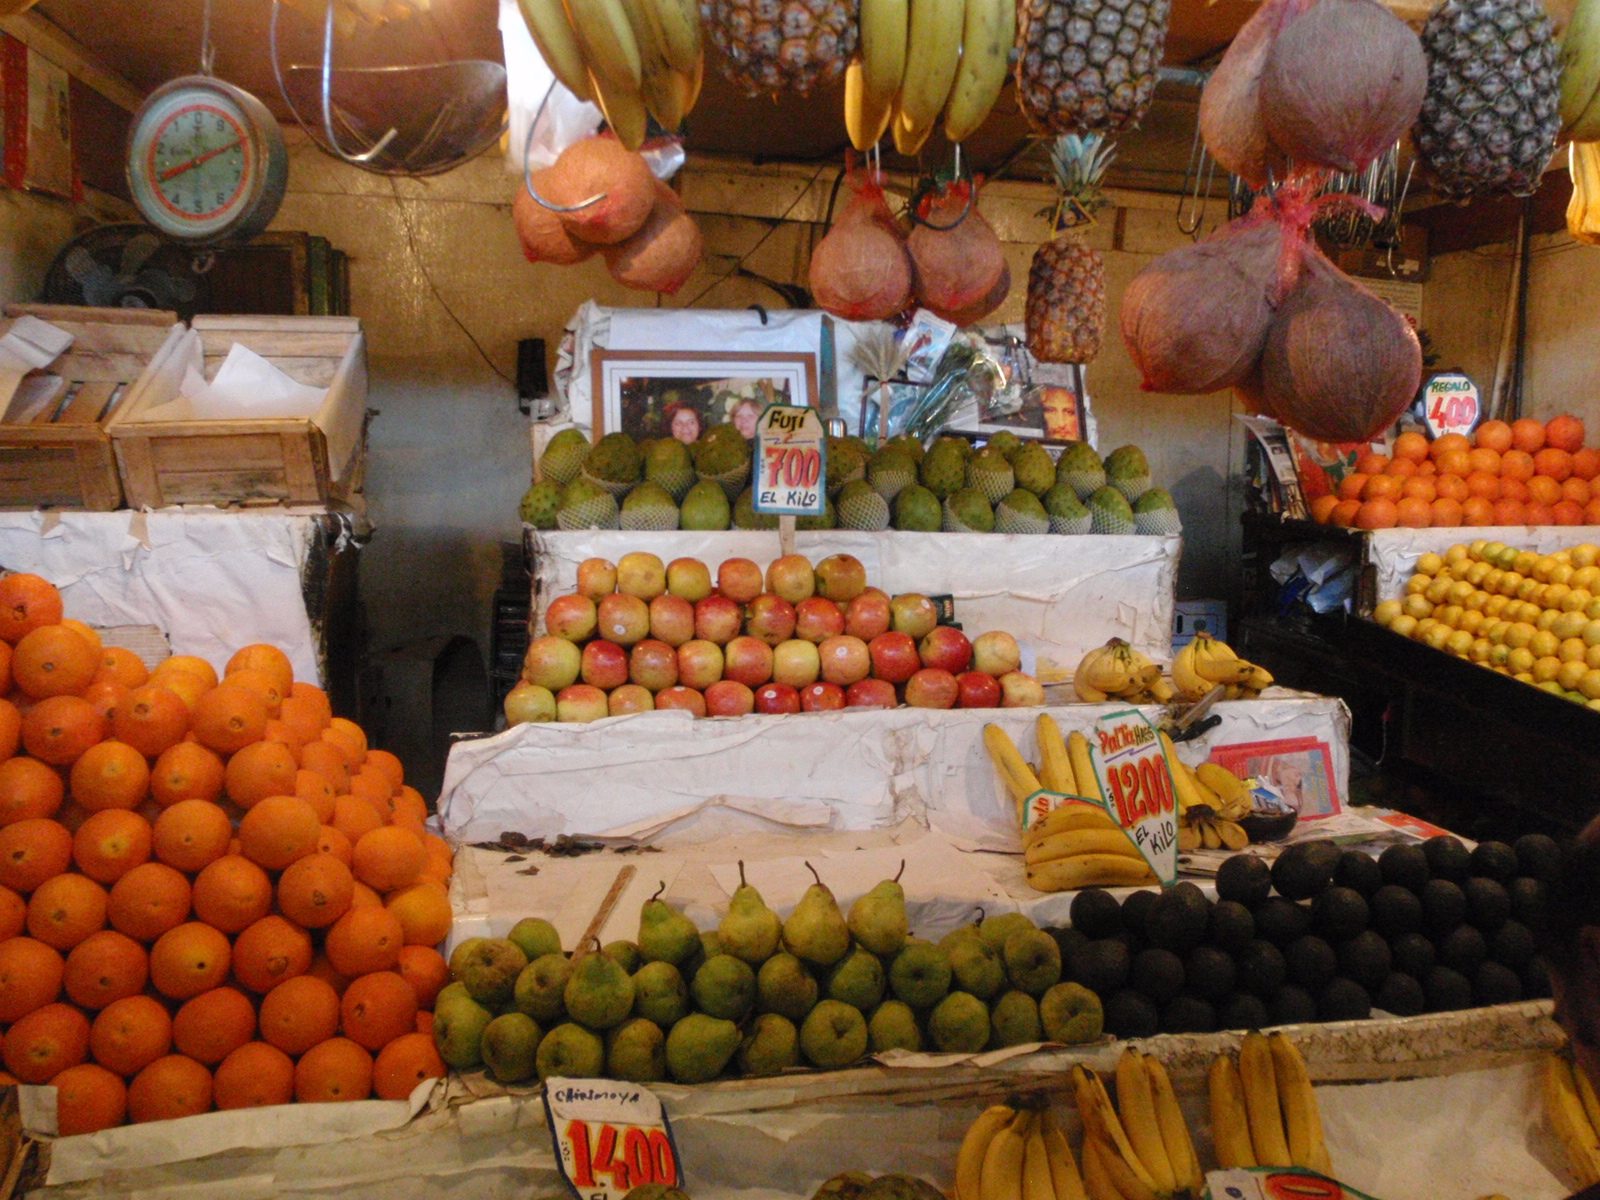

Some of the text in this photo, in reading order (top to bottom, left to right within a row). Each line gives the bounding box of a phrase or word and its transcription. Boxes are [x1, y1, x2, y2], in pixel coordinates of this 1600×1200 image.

[1431, 381, 1470, 392] REGALO
[1429, 396, 1477, 429] 400
[765, 447, 821, 488] 700
[760, 492, 776, 504] EL
[1107, 753, 1174, 829] 1200
[1135, 825, 1150, 846] EL
[566, 1119, 677, 1190] 1400
